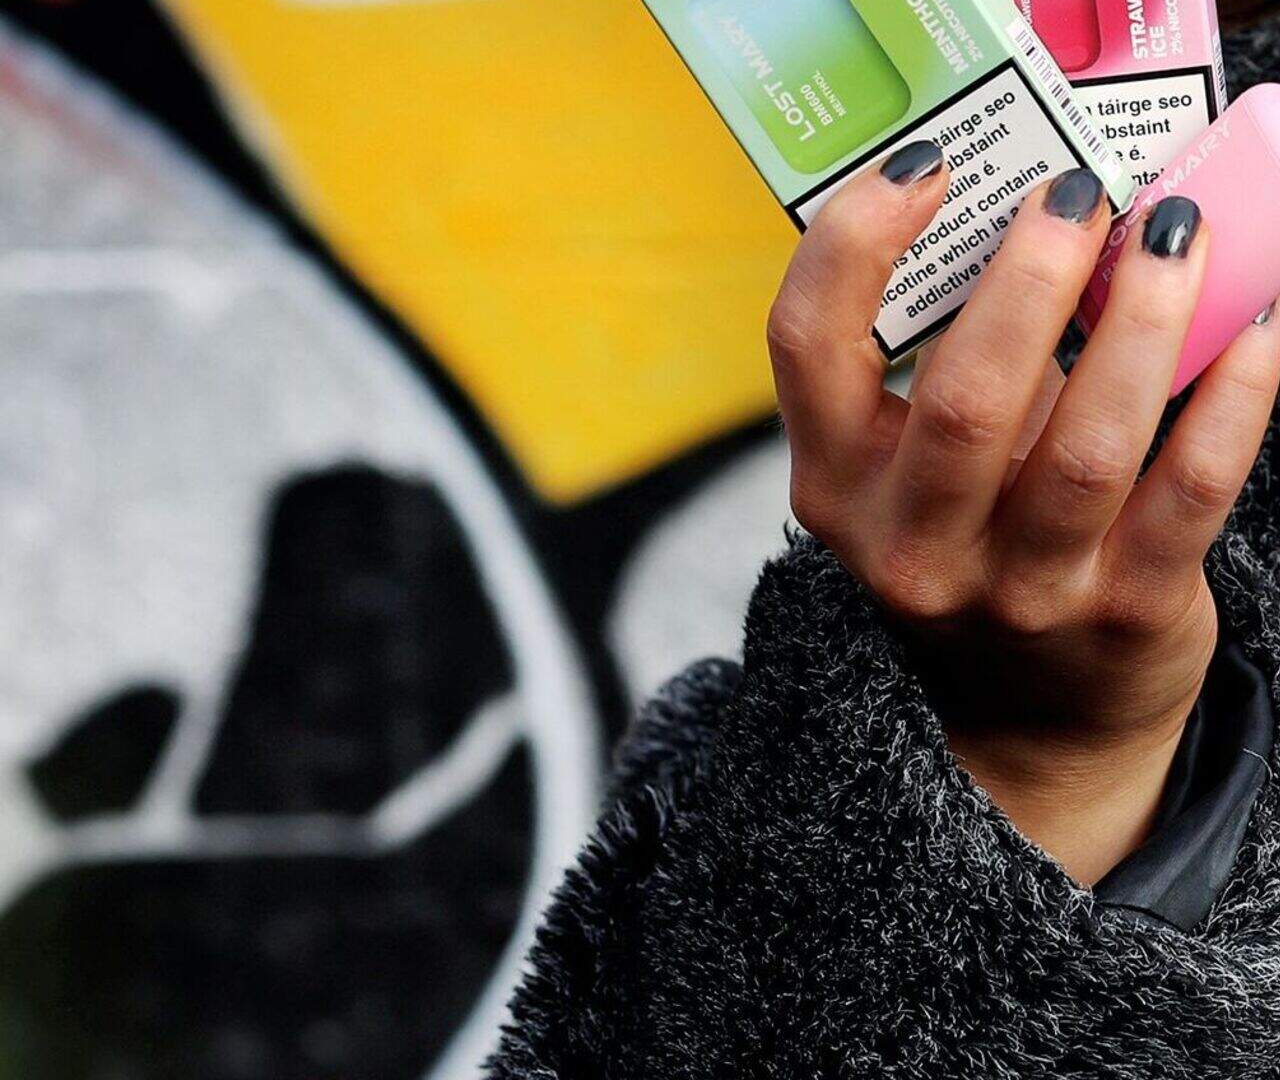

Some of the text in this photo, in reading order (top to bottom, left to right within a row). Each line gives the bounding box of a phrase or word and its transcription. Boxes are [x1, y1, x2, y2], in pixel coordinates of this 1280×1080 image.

[1148, 25, 1168, 58] ICE
[763, 81, 816, 142] LOST
[800, 83, 834, 126] BM600
[812, 69, 847, 117] MENTHOL
[984, 90, 1016, 118] seo
[1097, 98, 1152, 117] táirge
[1158, 94, 1193, 110] seo
[947, 122, 1011, 173] bstaint
[1099, 118, 1172, 140] bstaint
[983, 160, 1002, 176] é.
[1161, 119, 1232, 195] MARY
[909, 206, 977, 260] product
[977, 160, 1050, 213] contains
[880, 262, 938, 308] icotine
[938, 228, 991, 267] which
[989, 215, 1010, 233] is
[905, 262, 983, 319] addictive
